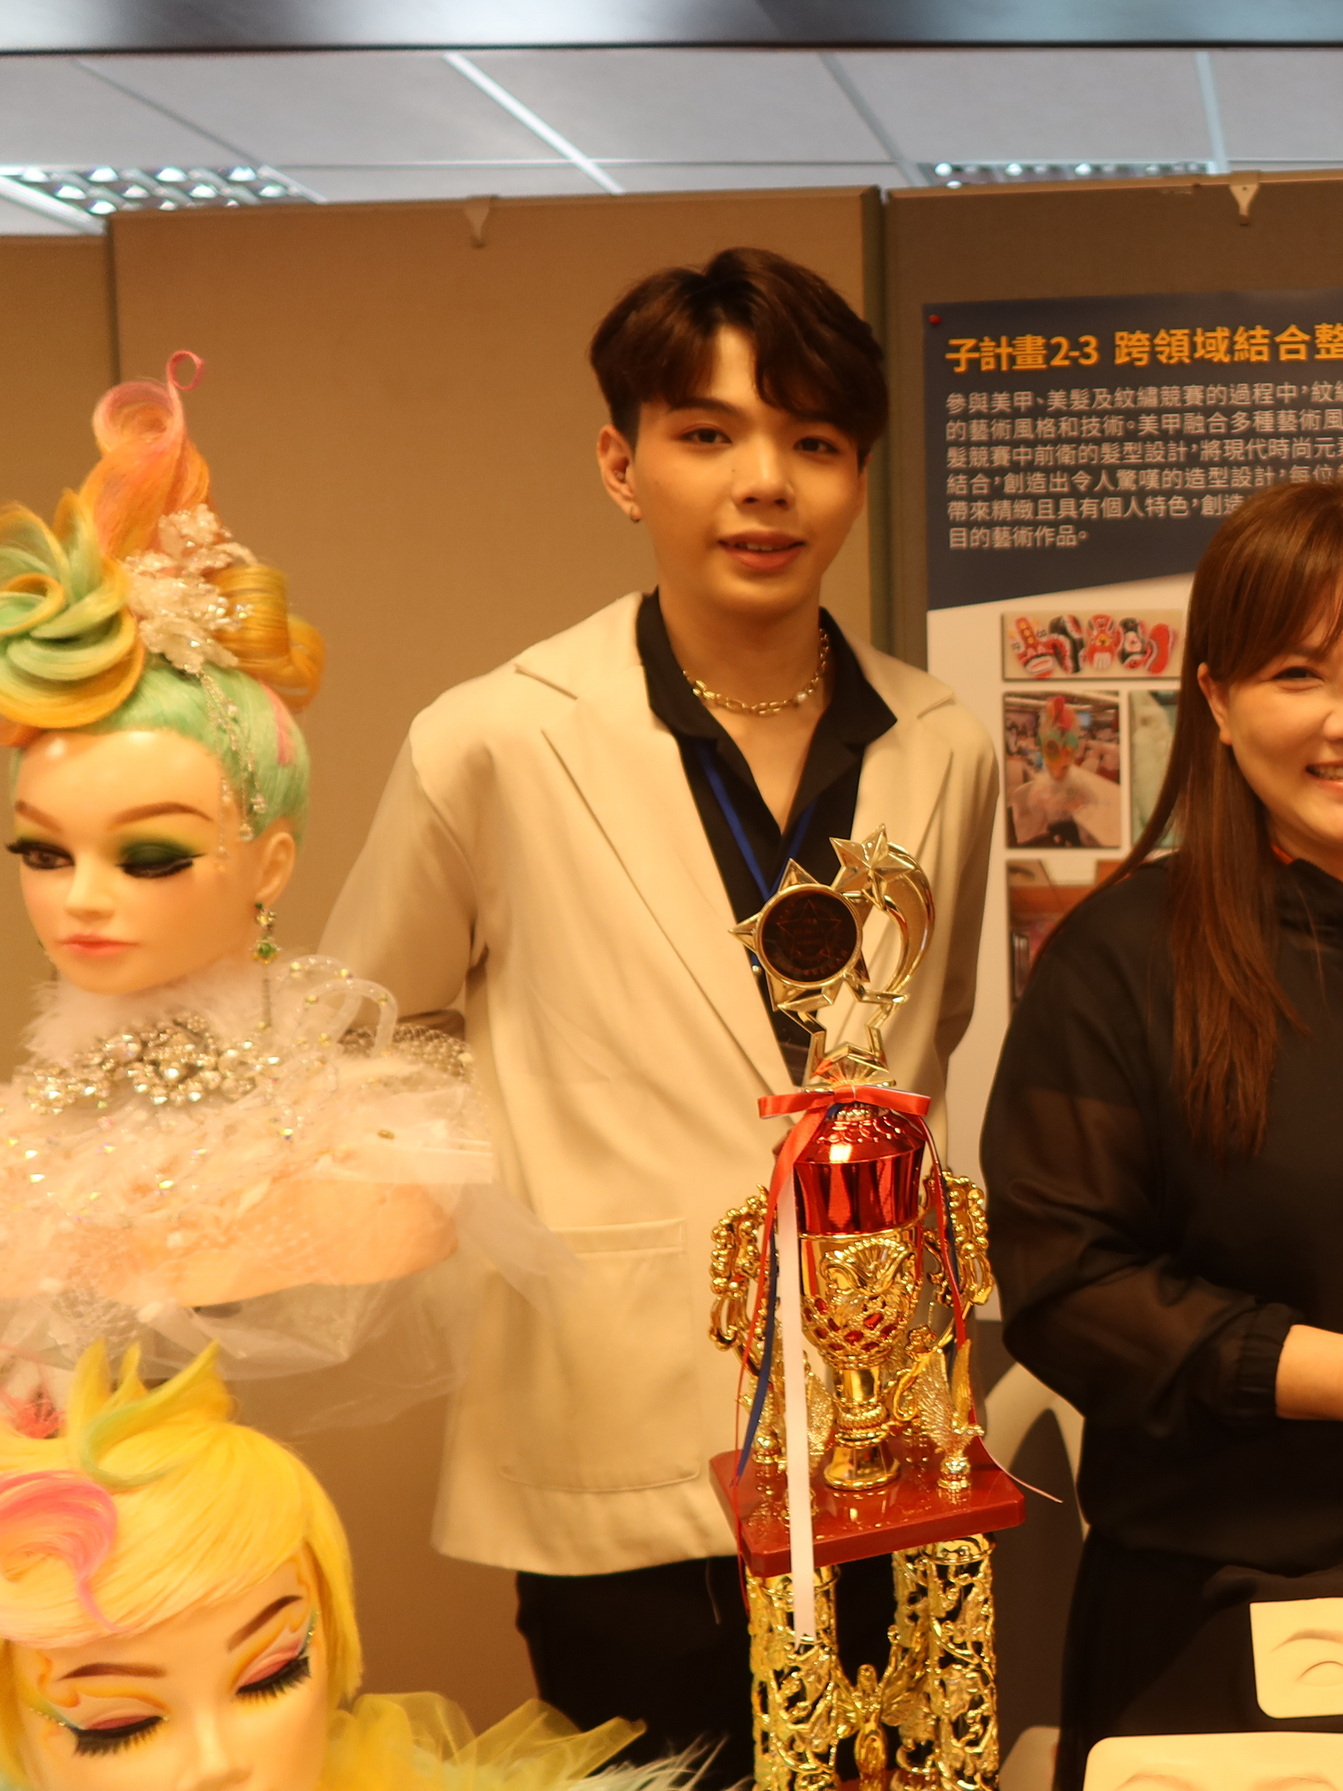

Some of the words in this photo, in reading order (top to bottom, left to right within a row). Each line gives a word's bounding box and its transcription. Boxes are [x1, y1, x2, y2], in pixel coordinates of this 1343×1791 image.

[945, 334, 1099, 373] 子計畫2-3
[949, 524, 1089, 550] 目的藝術作品。
